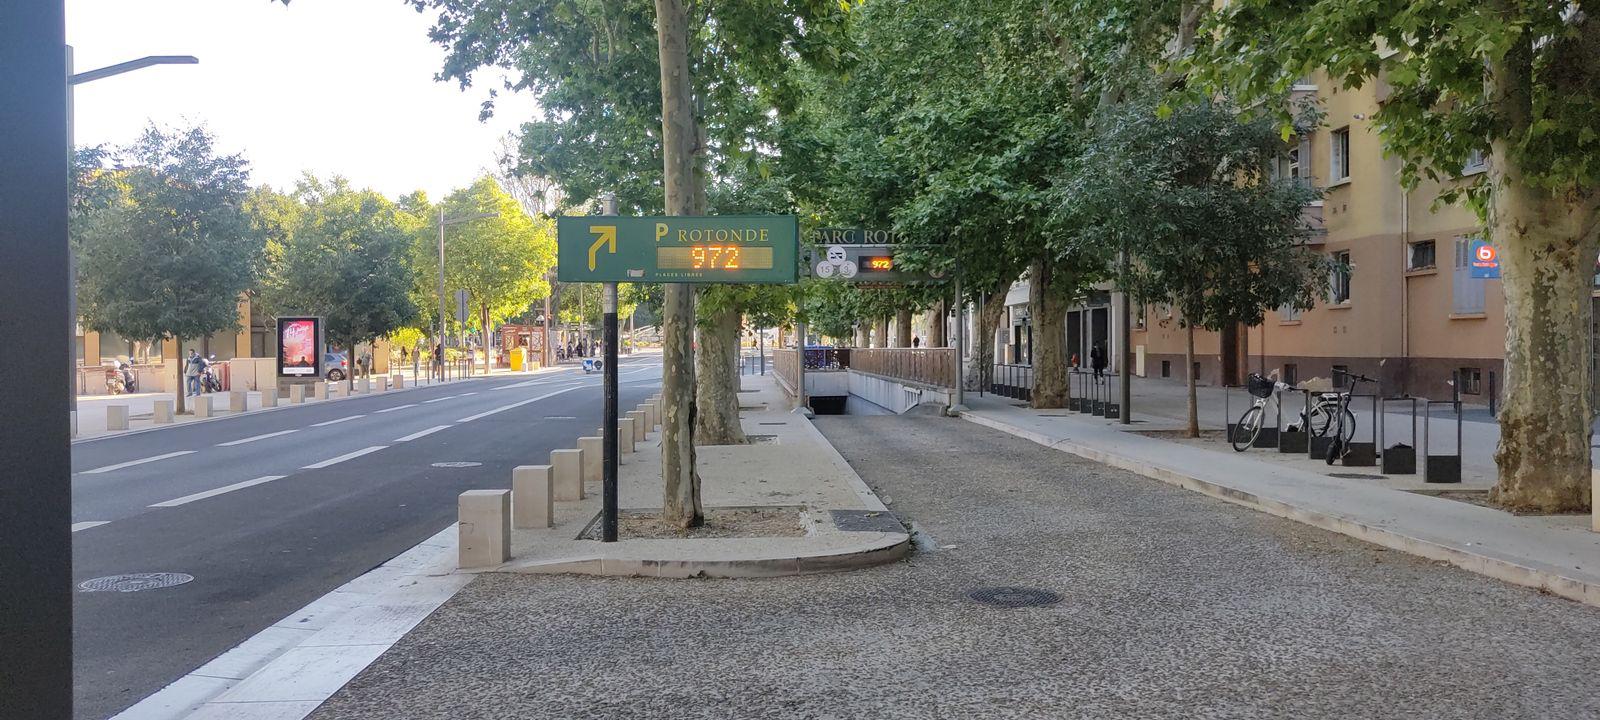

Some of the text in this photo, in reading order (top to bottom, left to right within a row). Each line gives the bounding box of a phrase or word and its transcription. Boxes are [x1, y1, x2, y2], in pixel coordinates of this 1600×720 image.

[655, 223, 769, 241] P ROTONDE
[812, 230, 855, 243] PARC
[691, 246, 739, 269] 972
[820, 265, 831, 273] 15
[871, 260, 890, 269] 972
